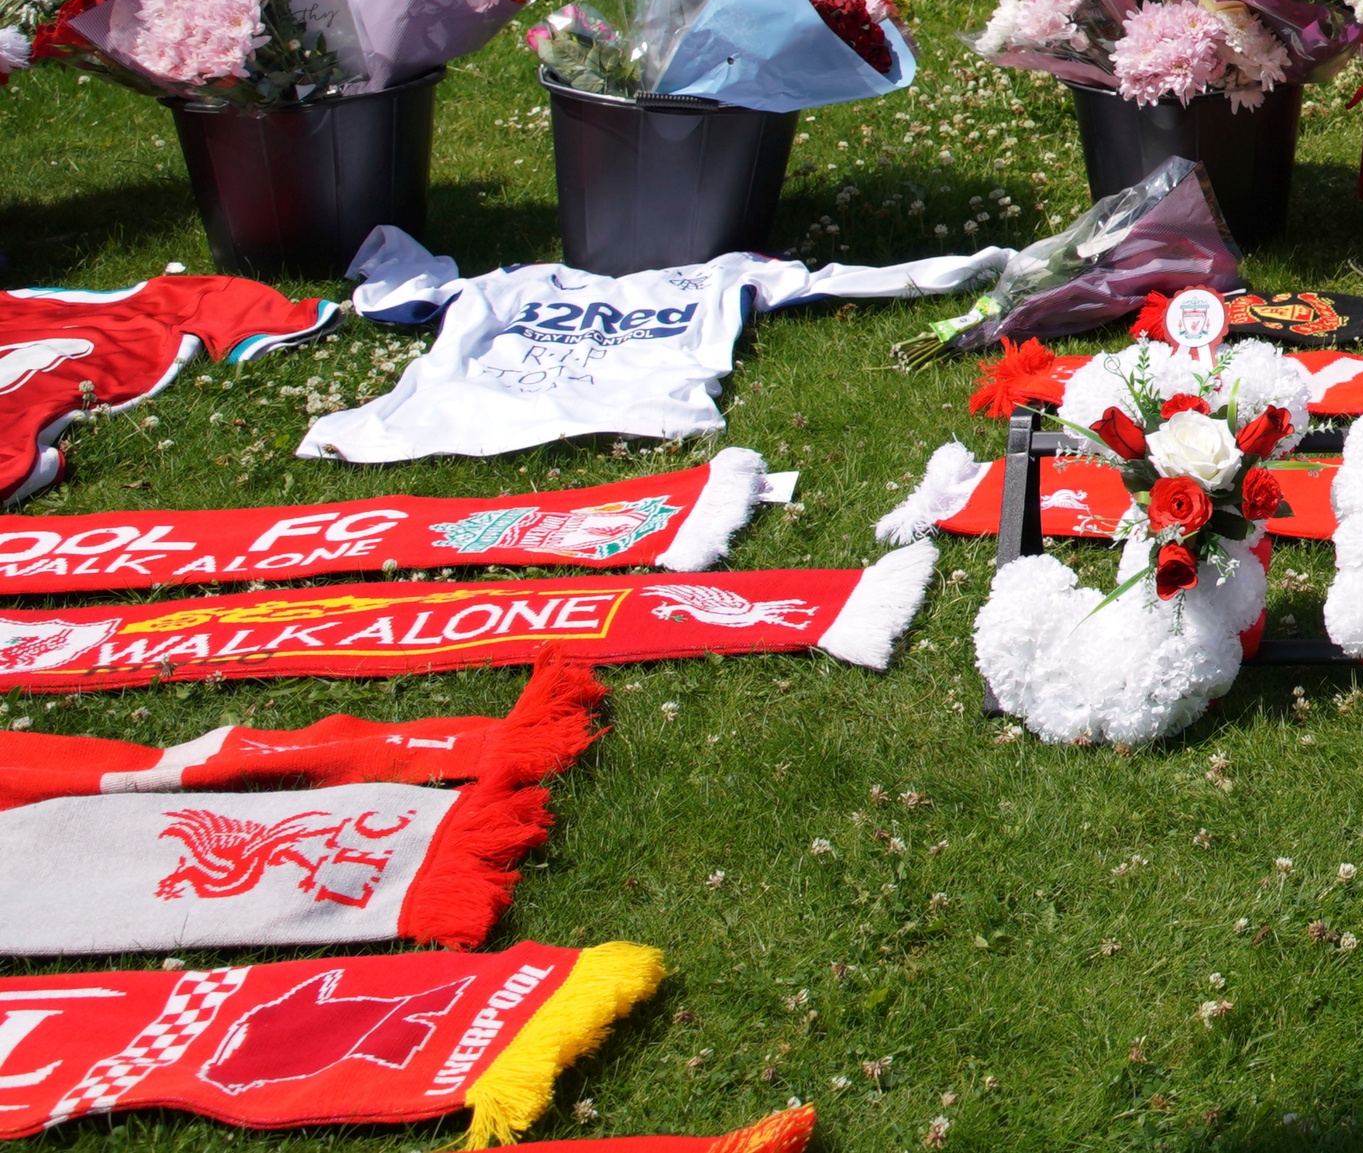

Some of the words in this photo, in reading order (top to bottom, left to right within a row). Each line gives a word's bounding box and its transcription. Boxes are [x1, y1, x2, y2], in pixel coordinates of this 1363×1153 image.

[515, 302, 699, 334] 32Red
[522, 328, 562, 342] STAY
[565, 334, 583, 344] IN
[583, 329, 654, 346] CONTROL
[248, 509, 409, 552] FC
[173, 538, 384, 576] ALONE
[93, 621, 344, 667] WALK
[334, 594, 616, 647] ALONE
[424, 964, 556, 1097] LIVERPOOL
